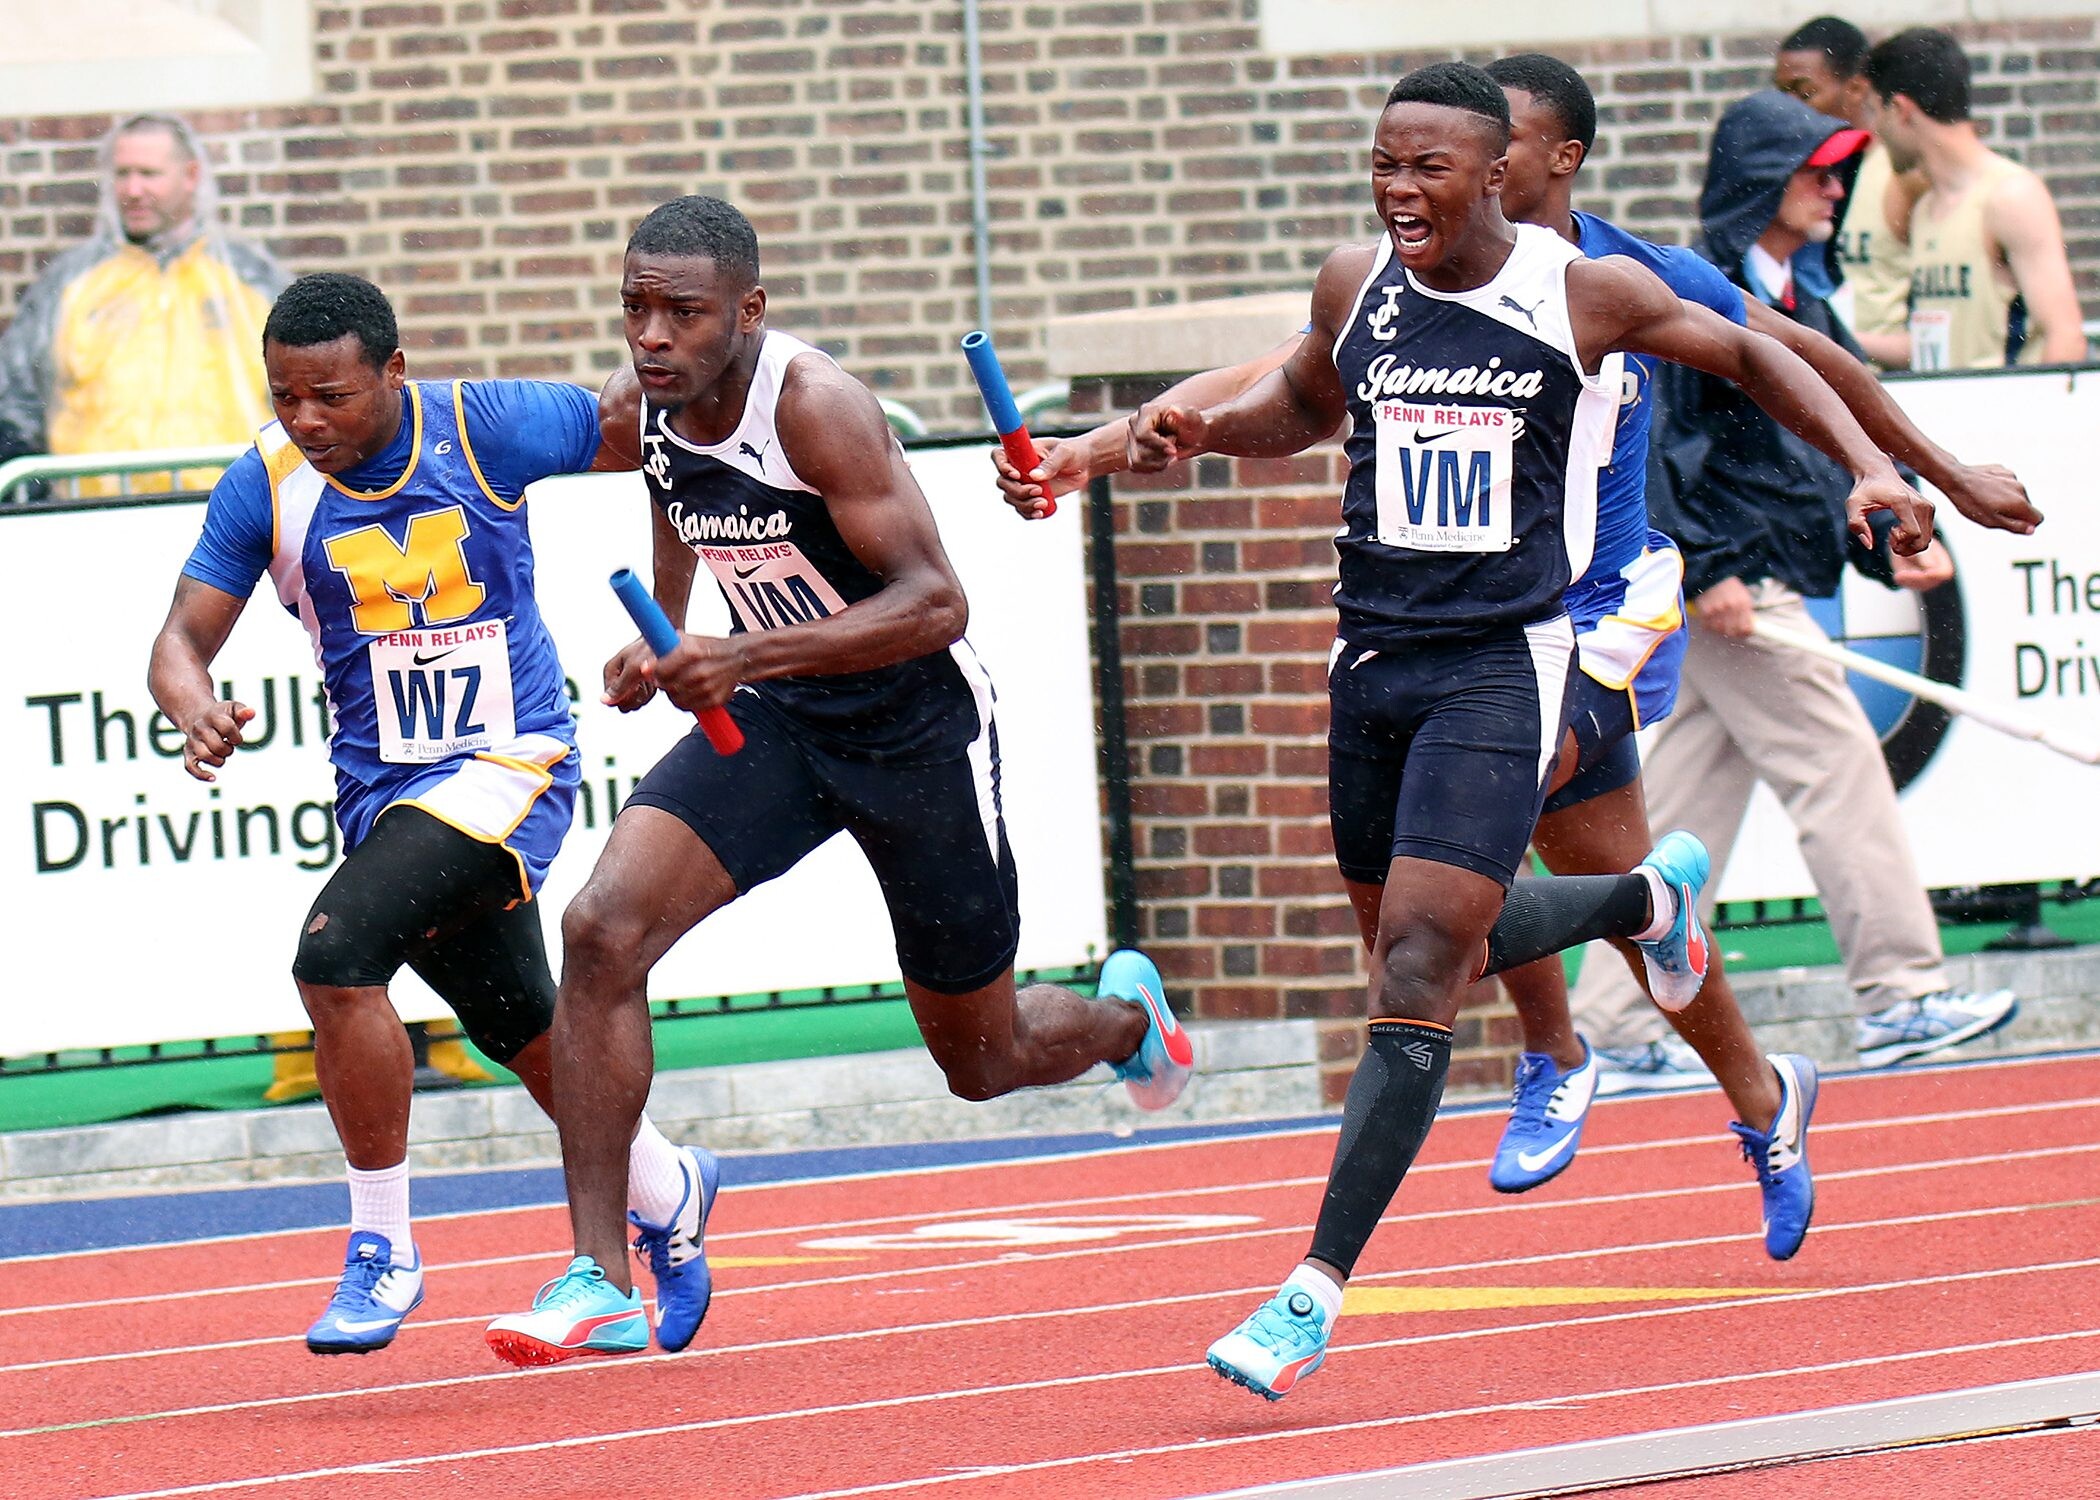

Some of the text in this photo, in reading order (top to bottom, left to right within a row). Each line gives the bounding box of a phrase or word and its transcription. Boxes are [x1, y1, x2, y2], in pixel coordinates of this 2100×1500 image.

[1357, 354, 1543, 401] Jamaica
[1383, 405, 1504, 426] PENN RELAYS
[1399, 447, 1491, 528] VM
[667, 502, 792, 543] Jamaica
[323, 505, 486, 634] M
[703, 545, 792, 562] PENN RELAYS
[733, 574, 829, 631] VM
[2012, 557, 2100, 616] The
[377, 624, 497, 647] PENN RELAYS
[25, 690, 186, 766] The
[387, 665, 486, 740] WZ
[32, 788, 338, 874] Driving
